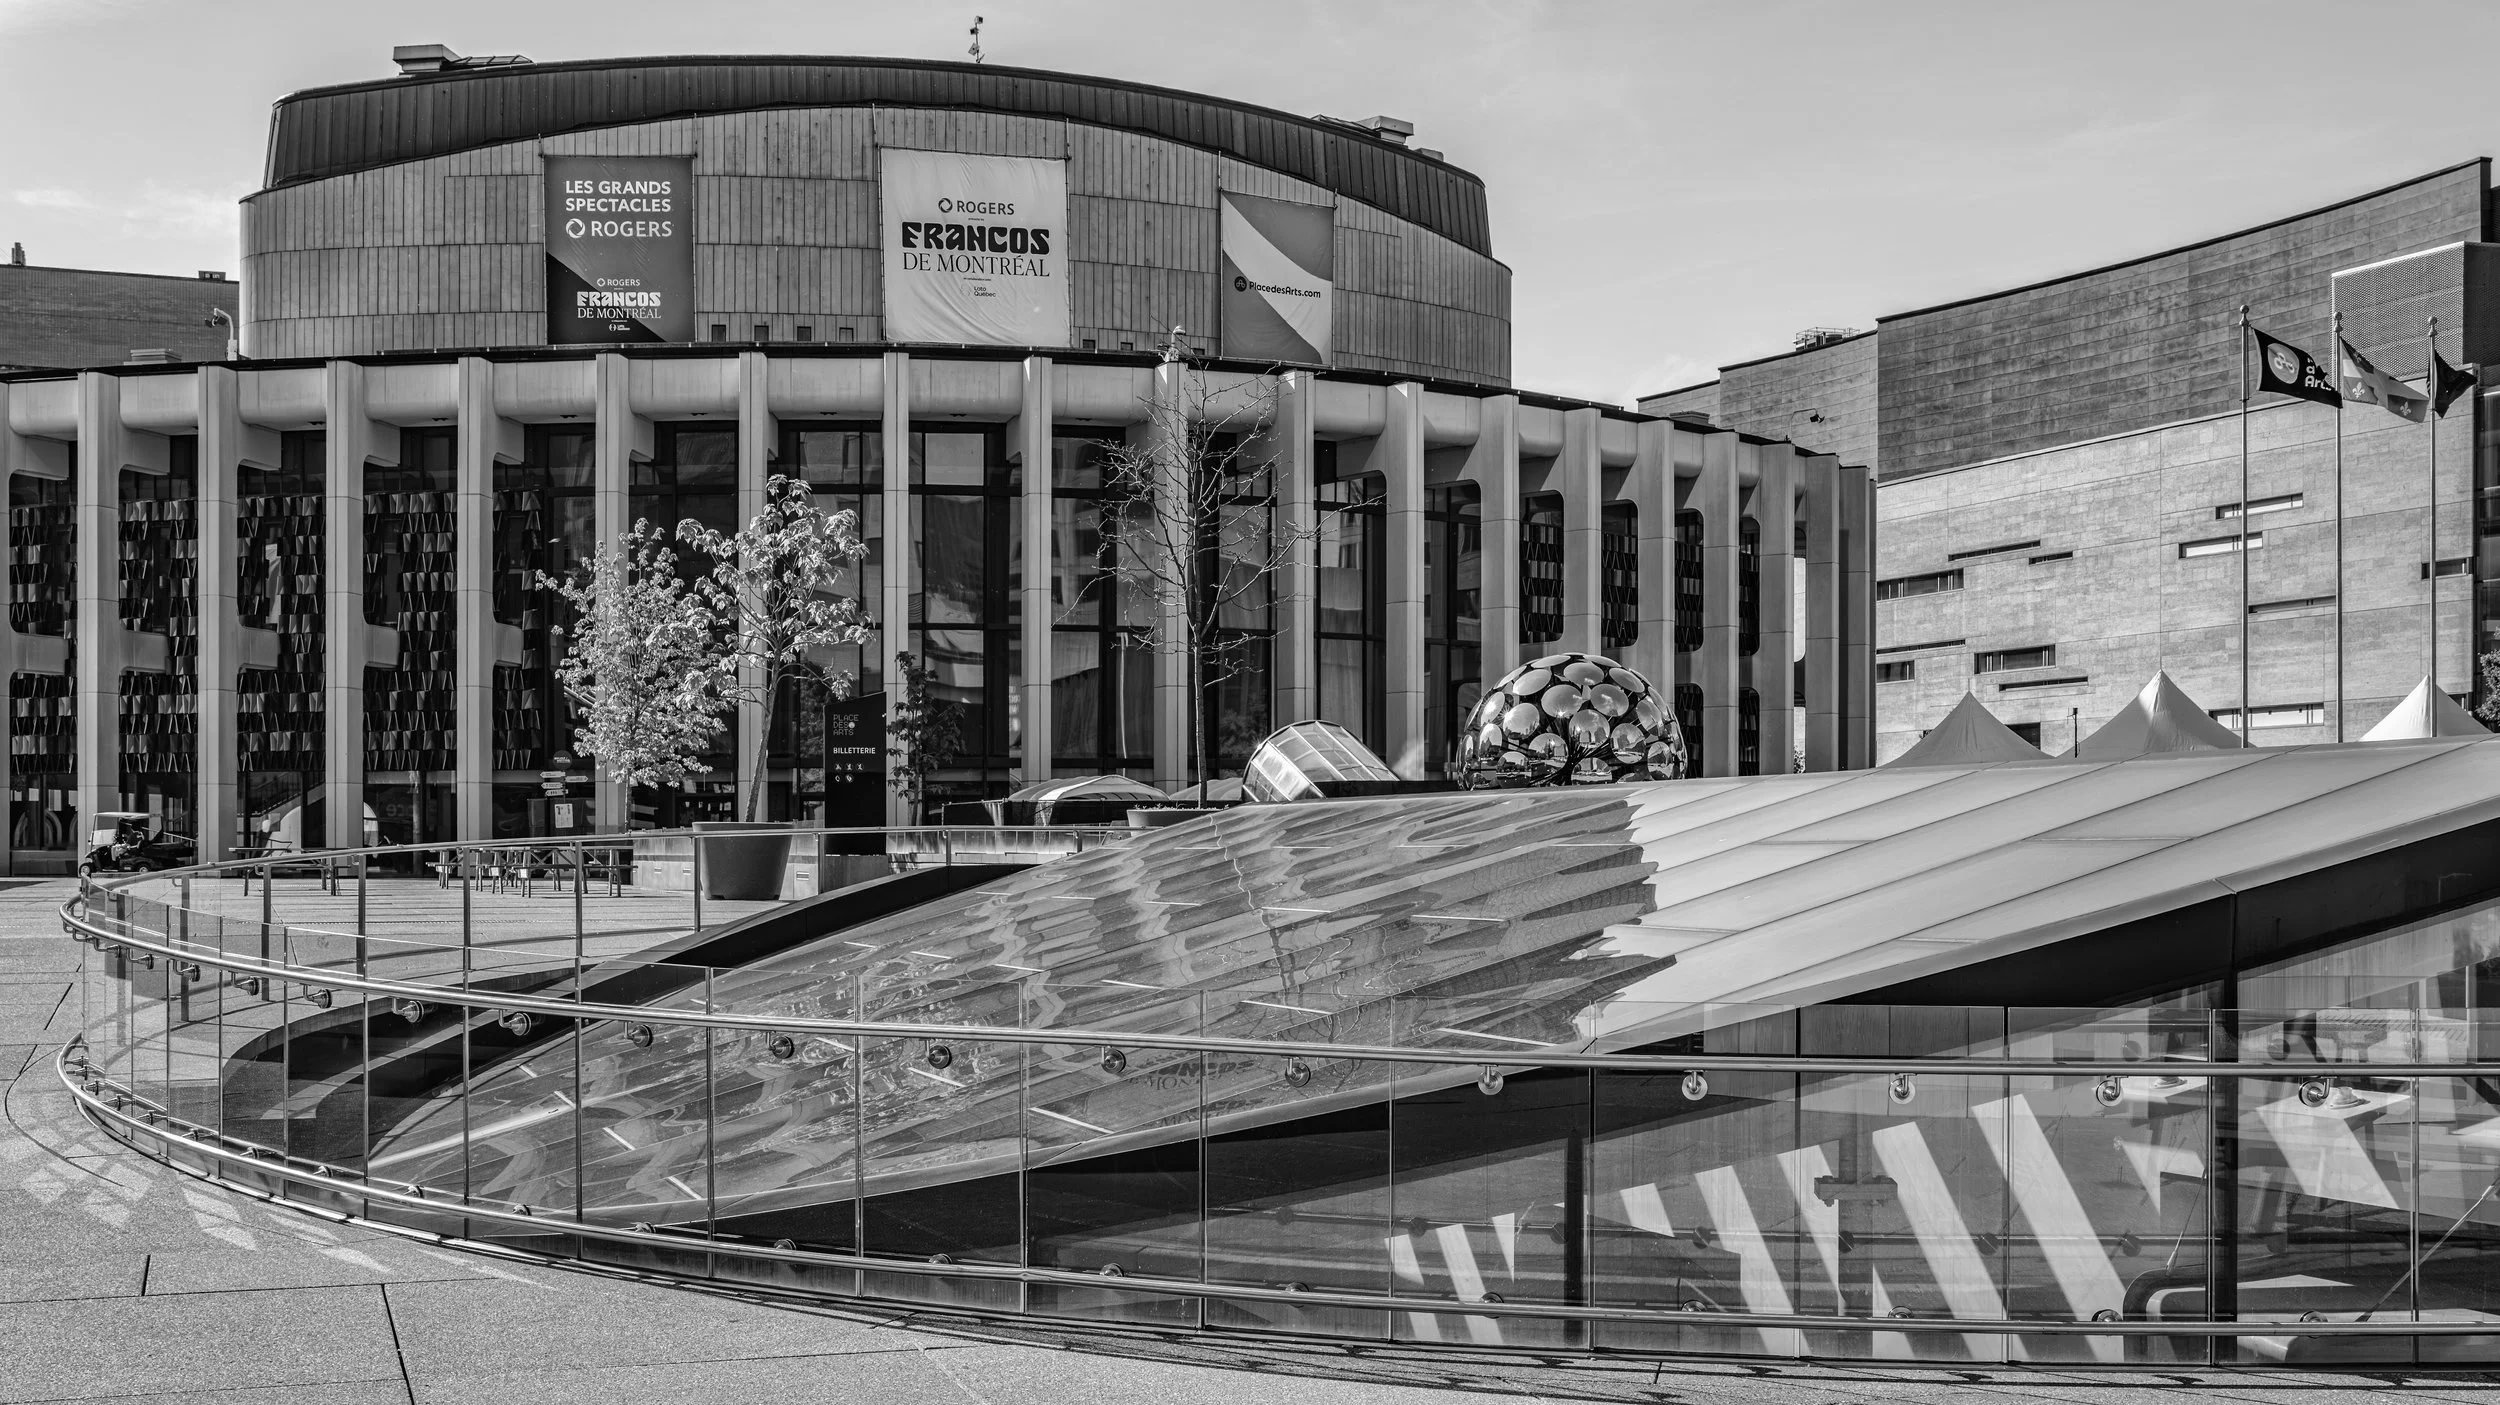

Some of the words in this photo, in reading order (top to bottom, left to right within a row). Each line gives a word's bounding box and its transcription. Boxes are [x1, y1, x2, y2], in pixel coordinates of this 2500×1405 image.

[565, 180, 594, 194] LES
[598, 180, 671, 195] GRANDS
[565, 198, 672, 212] SPECTACLES
[956, 200, 1015, 216] ROGERS
[591, 220, 672, 238] ROGERS
[901, 221, 1050, 255] FRANCOS
[903, 252, 931, 272] DE
[937, 254, 1050, 277] MONTRÉAL
[607, 278, 641, 287] ROGERS
[1249, 281, 1321, 298] PlacedesArts.com
[576, 291, 661, 307] FRANCOS
[577, 308, 594, 319] DE
[596, 306, 662, 319] MONTRÉAL
[833, 714, 860, 722] PLACE
[833, 721, 849, 729] DES
[833, 728, 854, 736] ARTS
